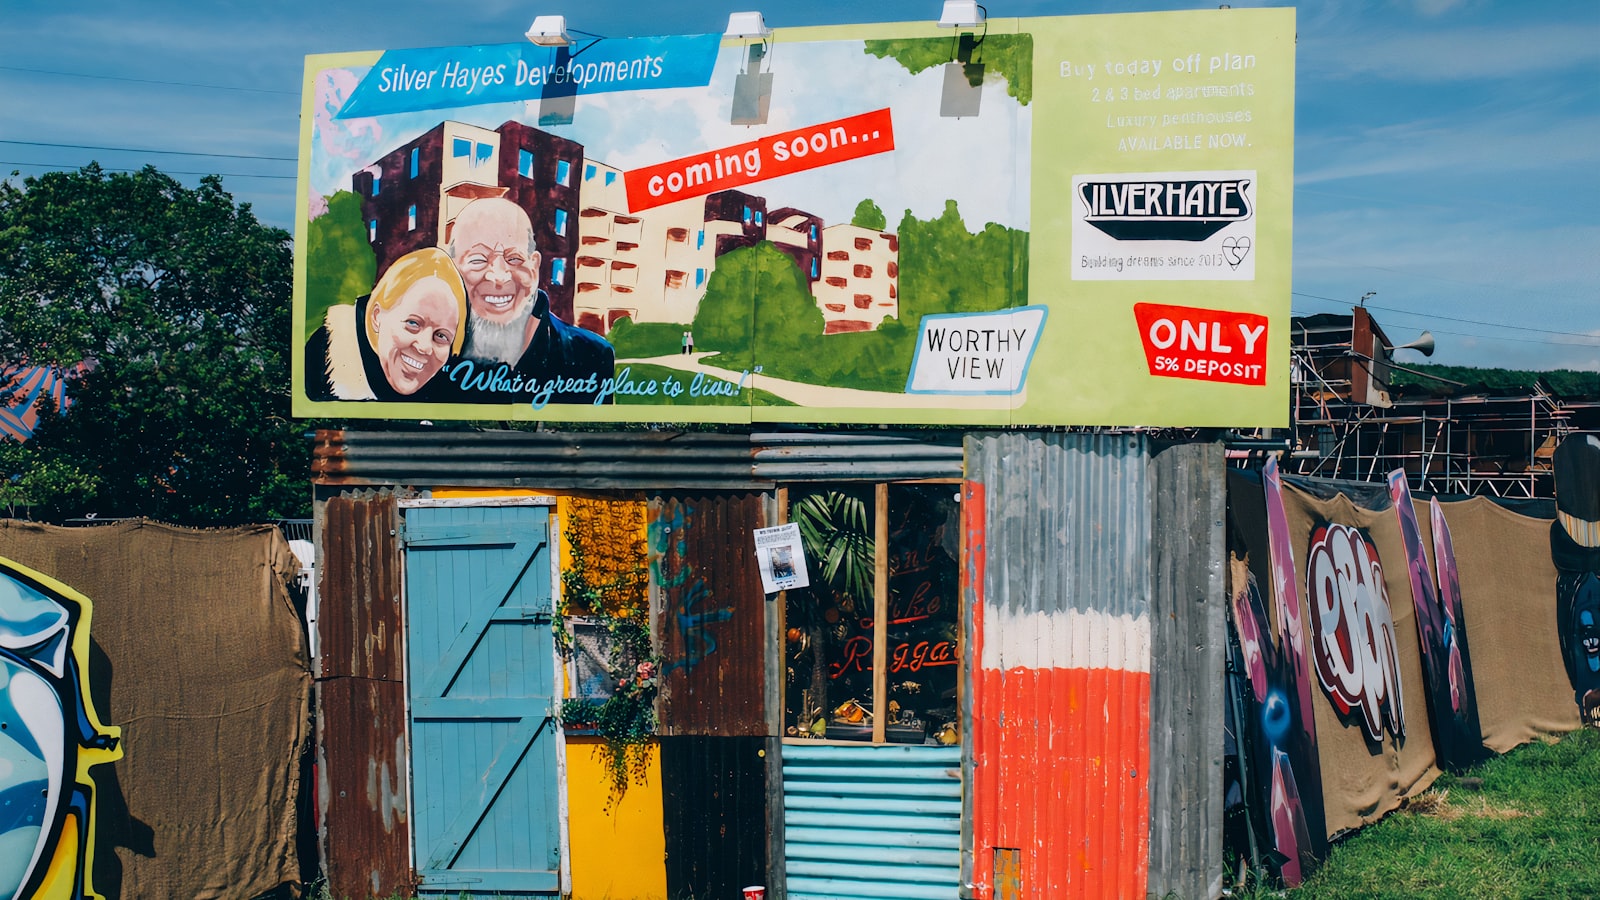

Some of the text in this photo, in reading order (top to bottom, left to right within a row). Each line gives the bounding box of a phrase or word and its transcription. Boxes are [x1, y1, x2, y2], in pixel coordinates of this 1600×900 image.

[379, 55, 664, 94] Silver Hayes Developments
[1060, 52, 1256, 80] Buy today off plan
[1092, 81, 1255, 102] 2 & 3 bed apartments
[1107, 109, 1252, 129] Luxury penthouses
[1118, 133, 1252, 152] AVAILABLE NOW.
[647, 126, 880, 197] coming soon...
[1081, 254, 1223, 272] Building dreams since 2013
[927, 328, 1027, 353] WORTHY
[1149, 318, 1266, 355] ONLY
[947, 357, 1004, 380] VIEW
[1154, 356, 1262, 380] 5% DEPOSIT
[524, 379, 540, 394] a
[532, 371, 597, 410] great
[594, 367, 657, 406] place
[662, 373, 685, 396] to
[829, 635, 960, 680] Rgga
